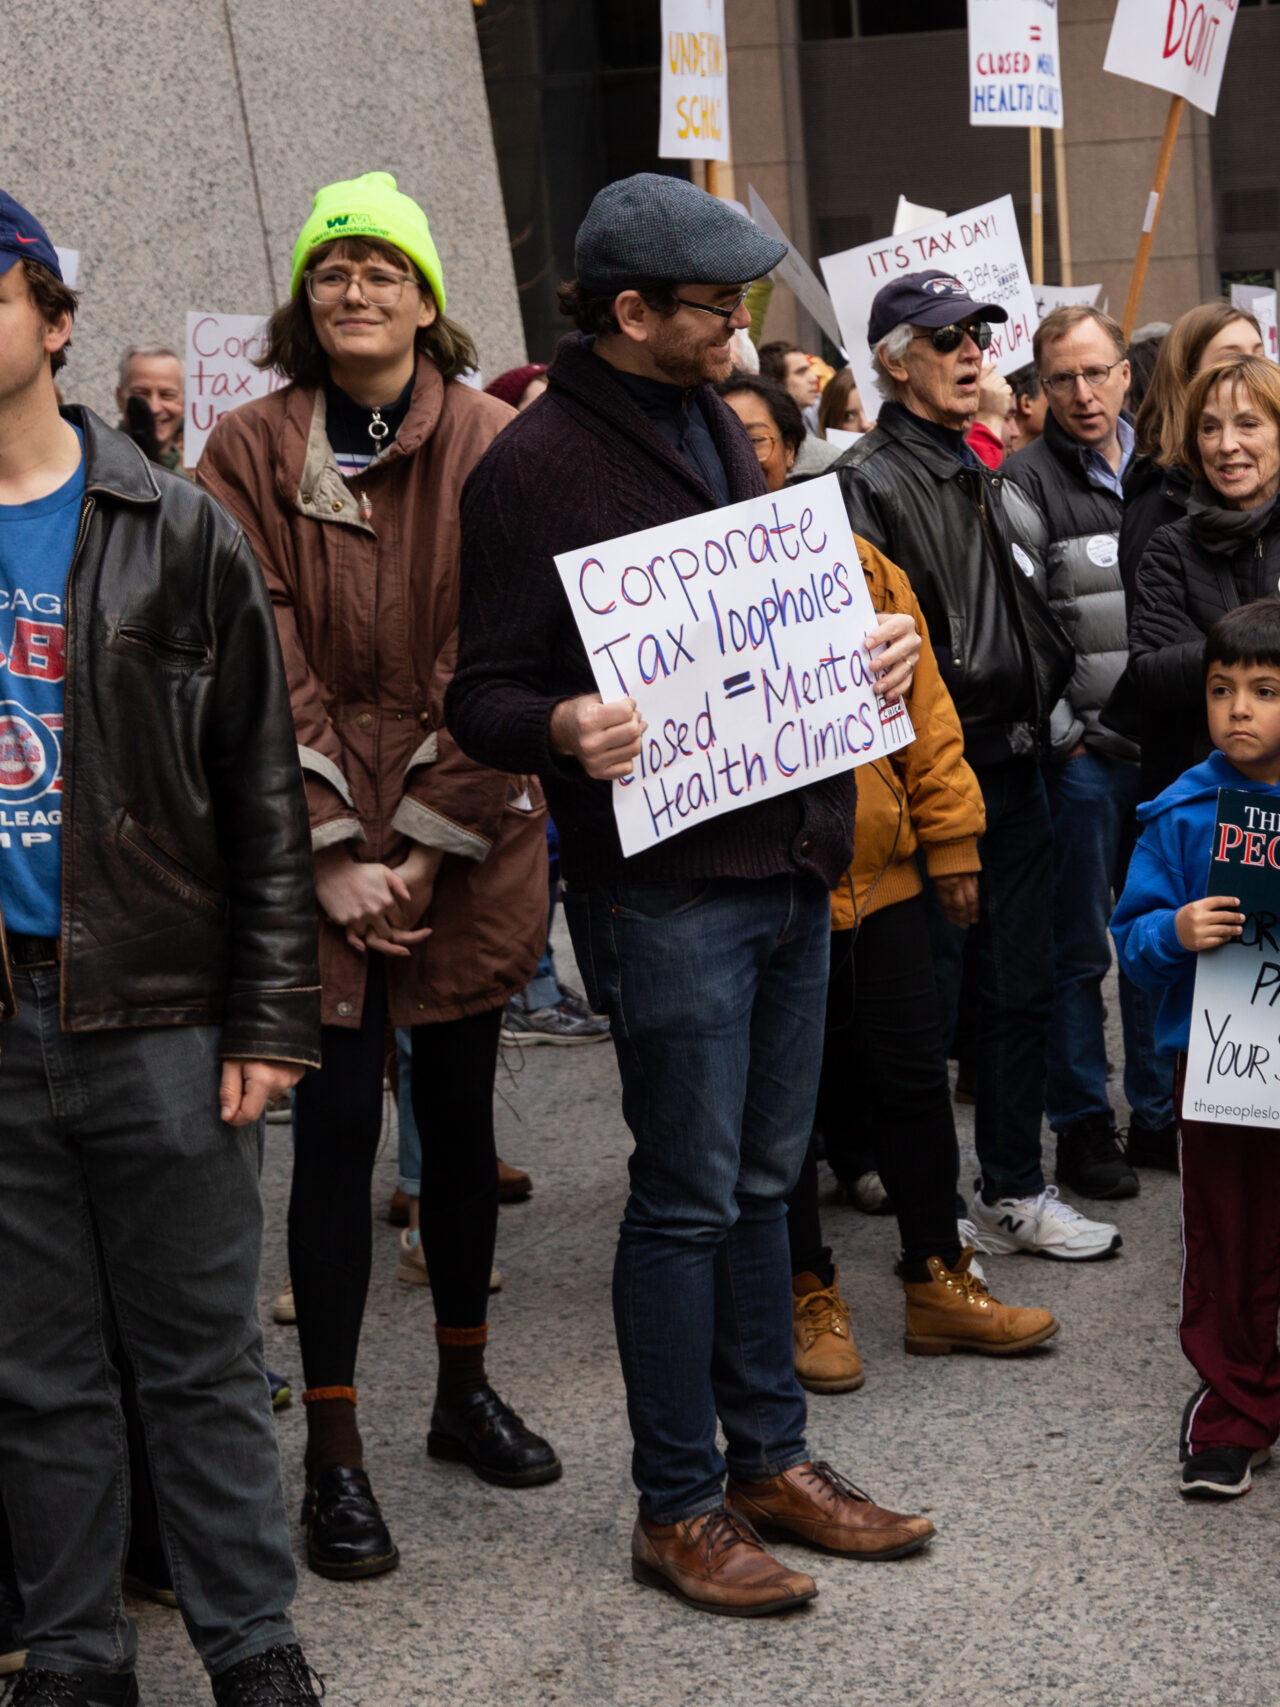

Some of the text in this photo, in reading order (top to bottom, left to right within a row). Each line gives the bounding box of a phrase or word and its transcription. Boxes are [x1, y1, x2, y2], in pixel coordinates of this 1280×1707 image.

[977, 52, 1030, 75] CLOSED
[868, 215, 998, 277] IT'S TAX DAY!
[190, 360, 252, 396] tax
[988, 335, 1003, 362] AY
[580, 503, 827, 622] Corporate
[593, 562, 852, 697] Tax loopholes
[643, 744, 767, 837] Health
[1204, 1009, 1270, 1085] YOUR
